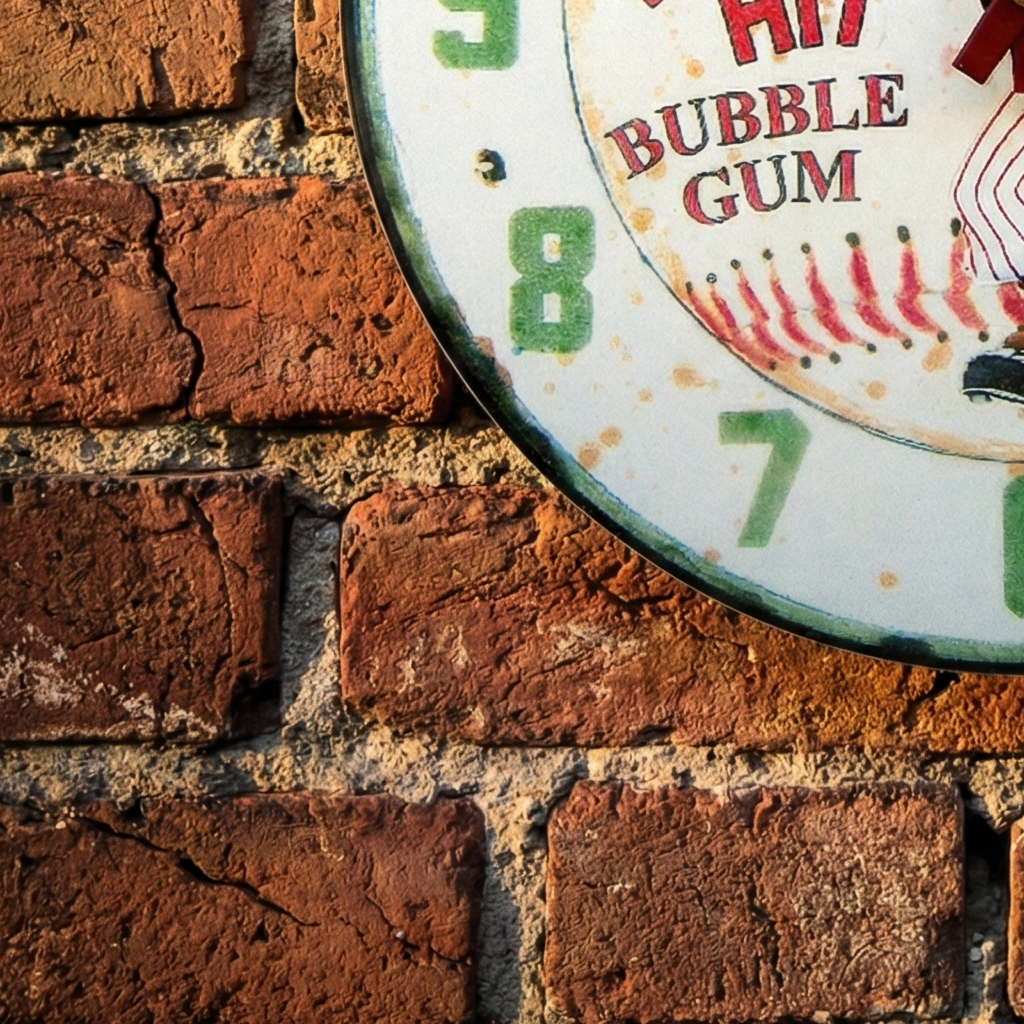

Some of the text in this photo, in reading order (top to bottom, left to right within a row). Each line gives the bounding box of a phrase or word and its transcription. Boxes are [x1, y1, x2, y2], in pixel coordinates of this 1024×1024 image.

[604, 73, 909, 179] BUBBLE
[682, 149, 862, 226] GUM
[508, 207, 594, 354] 8
[719, 410, 810, 548] 7
